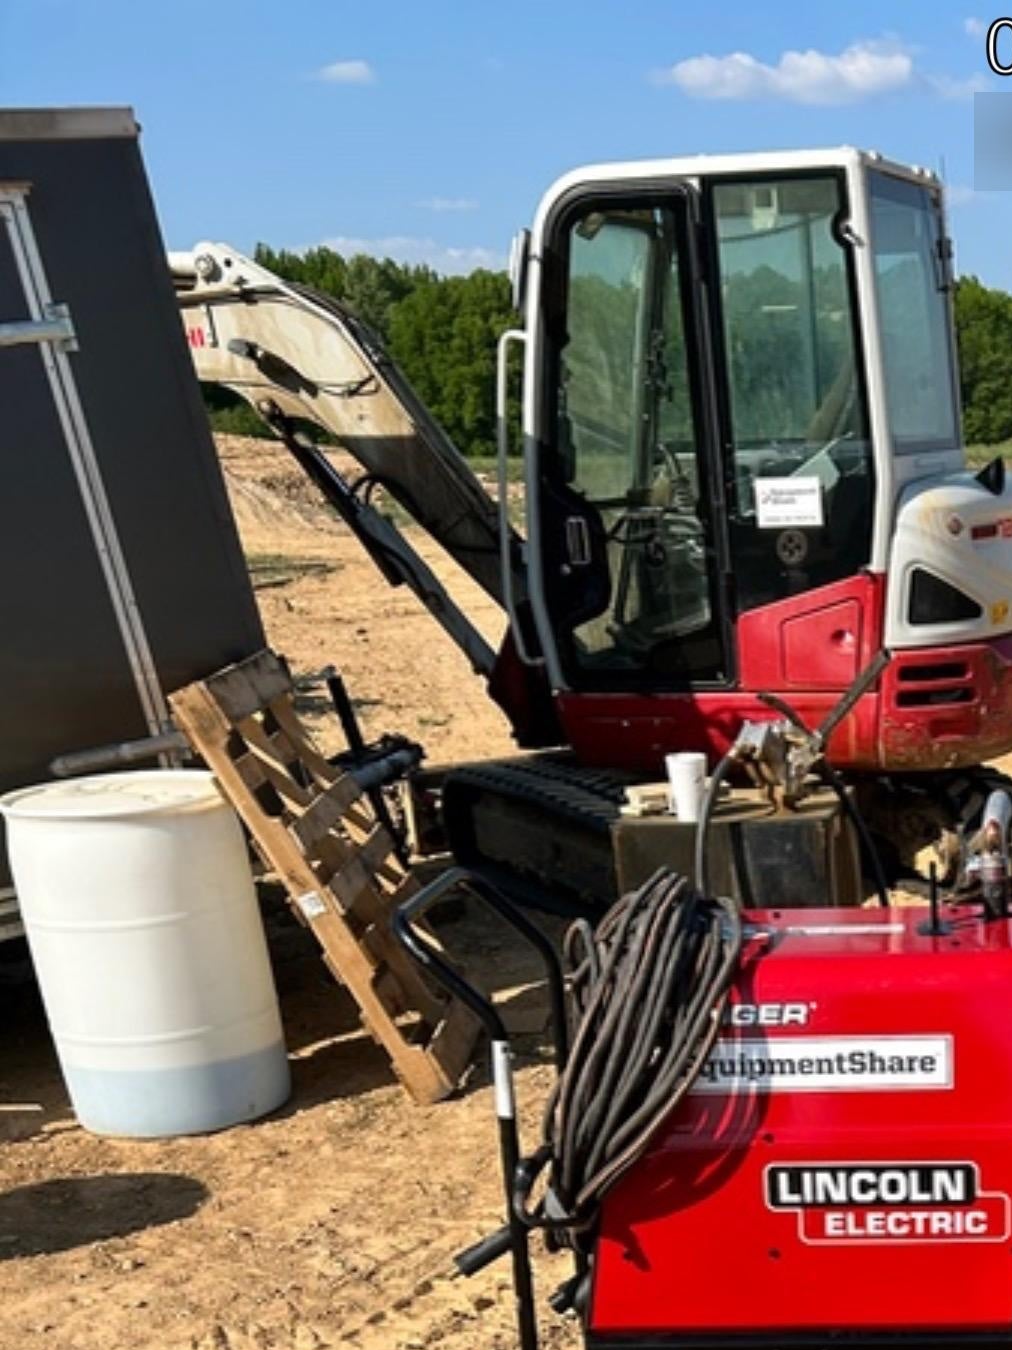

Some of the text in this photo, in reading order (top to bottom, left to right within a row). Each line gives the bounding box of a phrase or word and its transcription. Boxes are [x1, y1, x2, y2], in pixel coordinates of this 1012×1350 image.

[711, 1003, 808, 1025] GER
[697, 1051, 937, 1083] quipmentShare
[777, 1169, 965, 1204] LINCOLN
[824, 1210, 988, 1237] ELECTRIC
